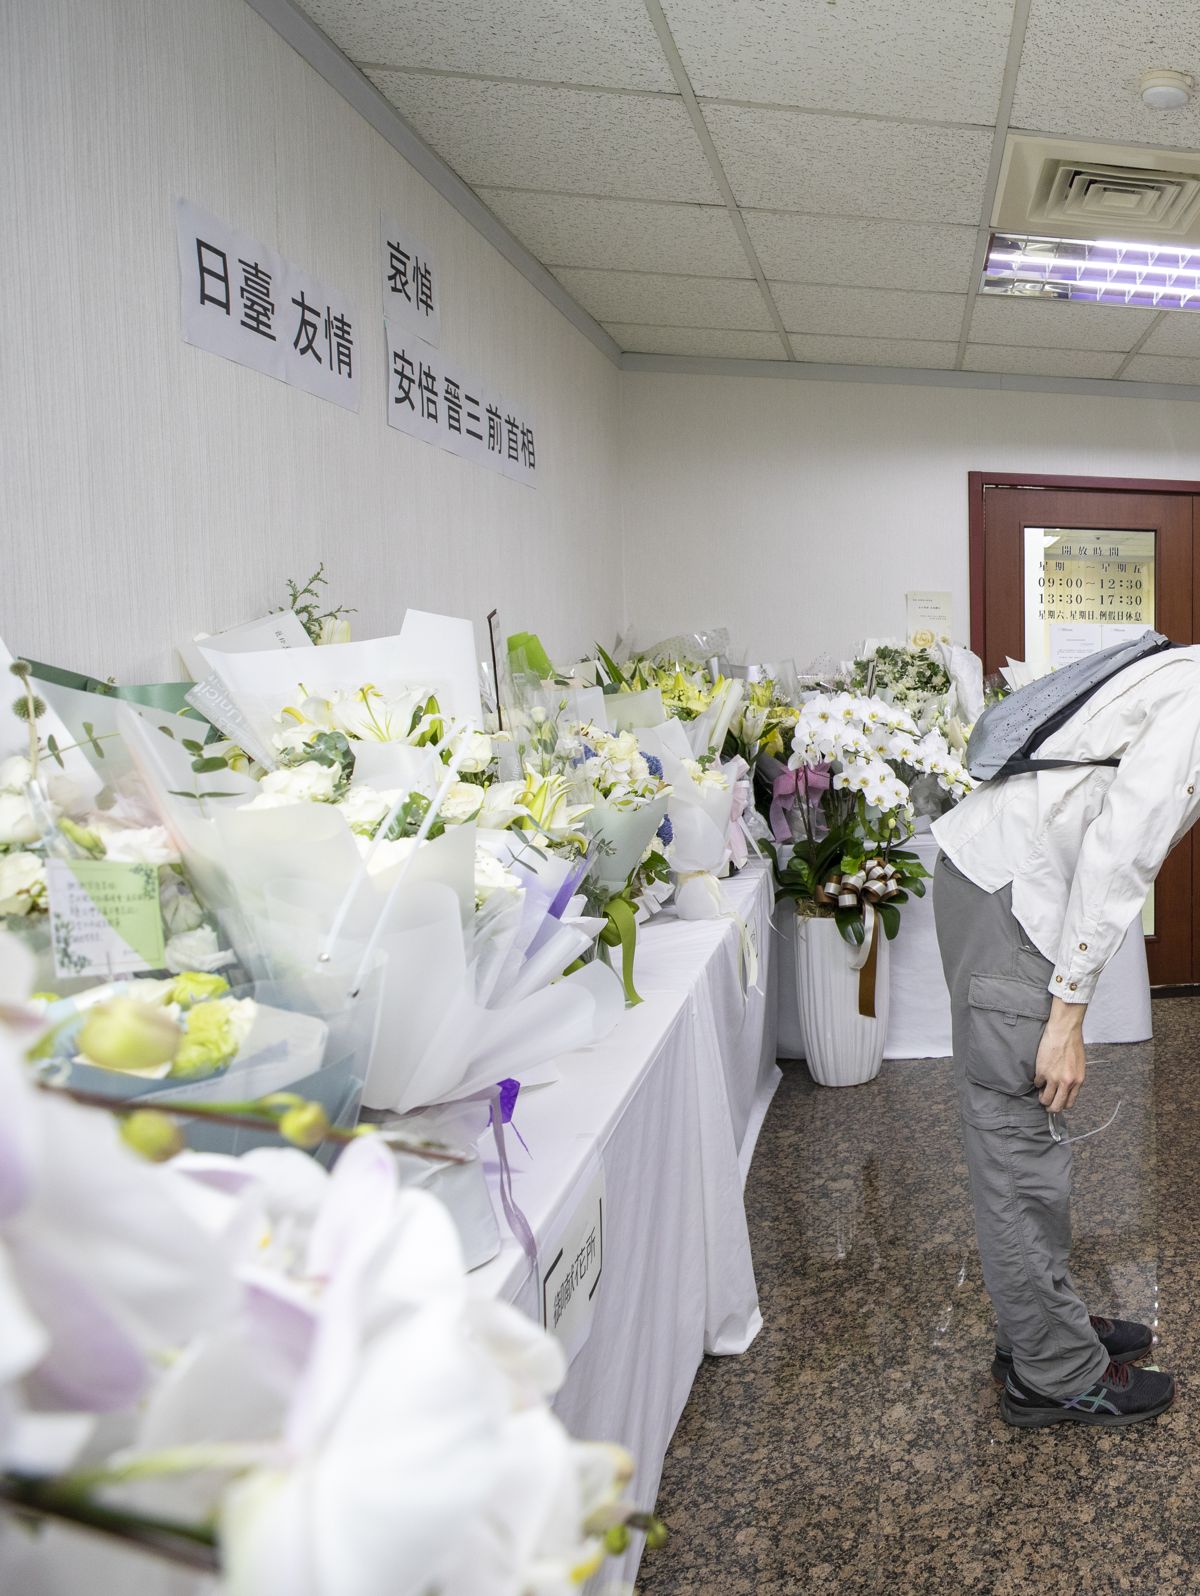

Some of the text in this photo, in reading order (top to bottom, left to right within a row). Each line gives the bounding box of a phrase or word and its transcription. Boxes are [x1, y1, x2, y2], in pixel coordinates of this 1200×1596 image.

[195, 237, 354, 379] 日臺 友情
[386, 239, 435, 317] 哀悼
[1061, 545, 1120, 557] 開放時間
